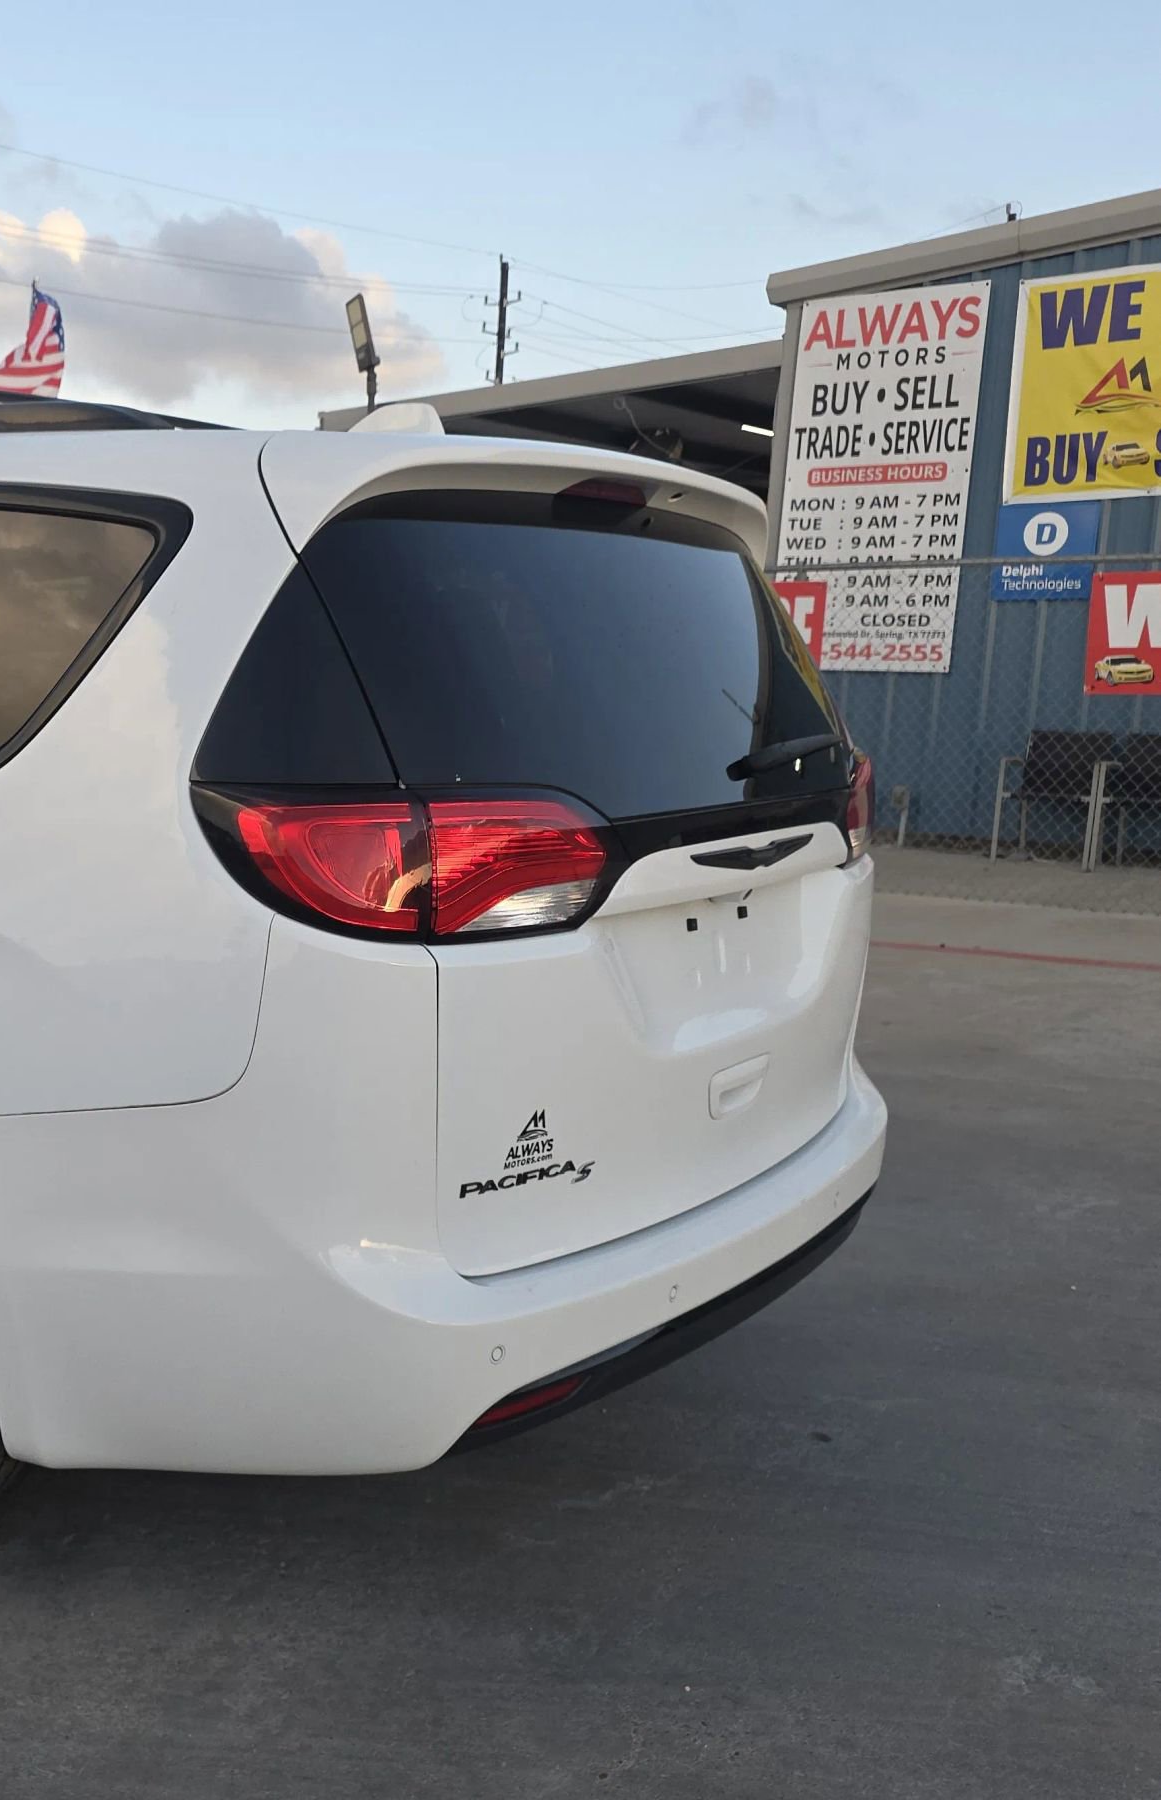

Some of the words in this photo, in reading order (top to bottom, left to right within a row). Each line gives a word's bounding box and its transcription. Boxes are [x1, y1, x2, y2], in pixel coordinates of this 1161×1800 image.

[804, 296, 982, 352] ALWAYS
[1040, 280, 1146, 350] WE
[836, 346, 947, 371] MOTORS
[811, 380, 870, 417] BUY
[894, 373, 960, 412] SELL
[795, 424, 863, 460] TRADE
[881, 417, 971, 456] SERVICE
[1024, 430, 1109, 487] BUY
[811, 467, 883, 484] BUSINESS
[888, 464, 944, 481] HOURS
[790, 497, 835, 512] MON
[855, 496, 865, 510] 9
[869, 495, 899, 510] AM
[916, 494, 927, 508] 7
[932, 492, 961, 507] PM
[788, 517, 822, 531] TUE
[853, 516, 863, 530] 9
[867, 515, 898, 529] AM
[914, 514, 925, 528] 7
[930, 513, 959, 527] PM
[786, 537, 827, 550] WED
[851, 536, 861, 549] 9
[865, 535, 896, 548] AM
[912, 534, 923, 548] 7
[928, 533, 957, 547] PM
[847, 575, 857, 588] 9
[861, 575, 890, 588] AM
[908, 574, 919, 588] 7
[923, 574, 952, 588] PM
[1002, 564, 1044, 580] Delphi
[1002, 578, 1081, 592] Technologies
[845, 595, 855, 607] 9
[859, 594, 889, 607] AM
[905, 594, 916, 607] 6
[921, 593, 951, 607] PM
[860, 614, 931, 627] CLOSED
[505, 1138, 554, 1161] ALWAYS
[503, 1153, 553, 1170] MOTORS.com
[459, 1160, 576, 1199] PACIFICA
